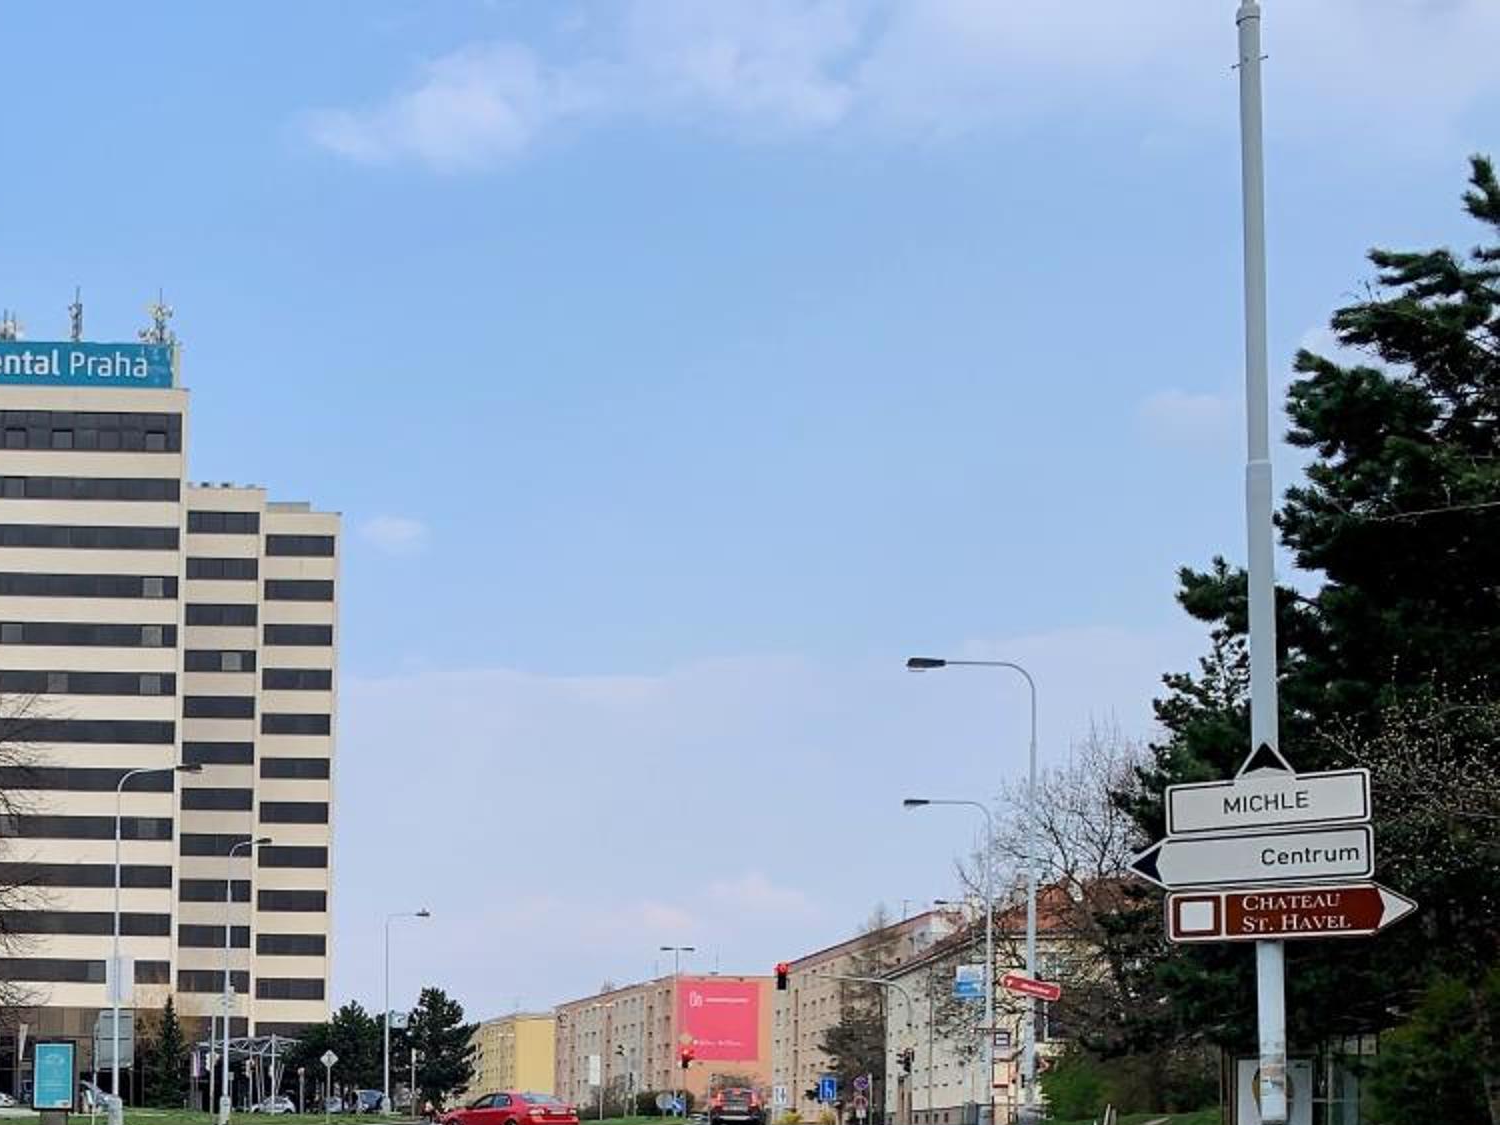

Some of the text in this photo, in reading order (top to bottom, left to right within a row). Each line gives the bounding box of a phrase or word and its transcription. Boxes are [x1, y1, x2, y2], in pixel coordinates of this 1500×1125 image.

[69, 351, 148, 378] Praha
[1223, 790, 1309, 815] MICHLE
[1261, 847, 1360, 866] Centrum
[1242, 893, 1341, 911] CHATEAU
[1242, 913, 1352, 932] ST. HAVEL
